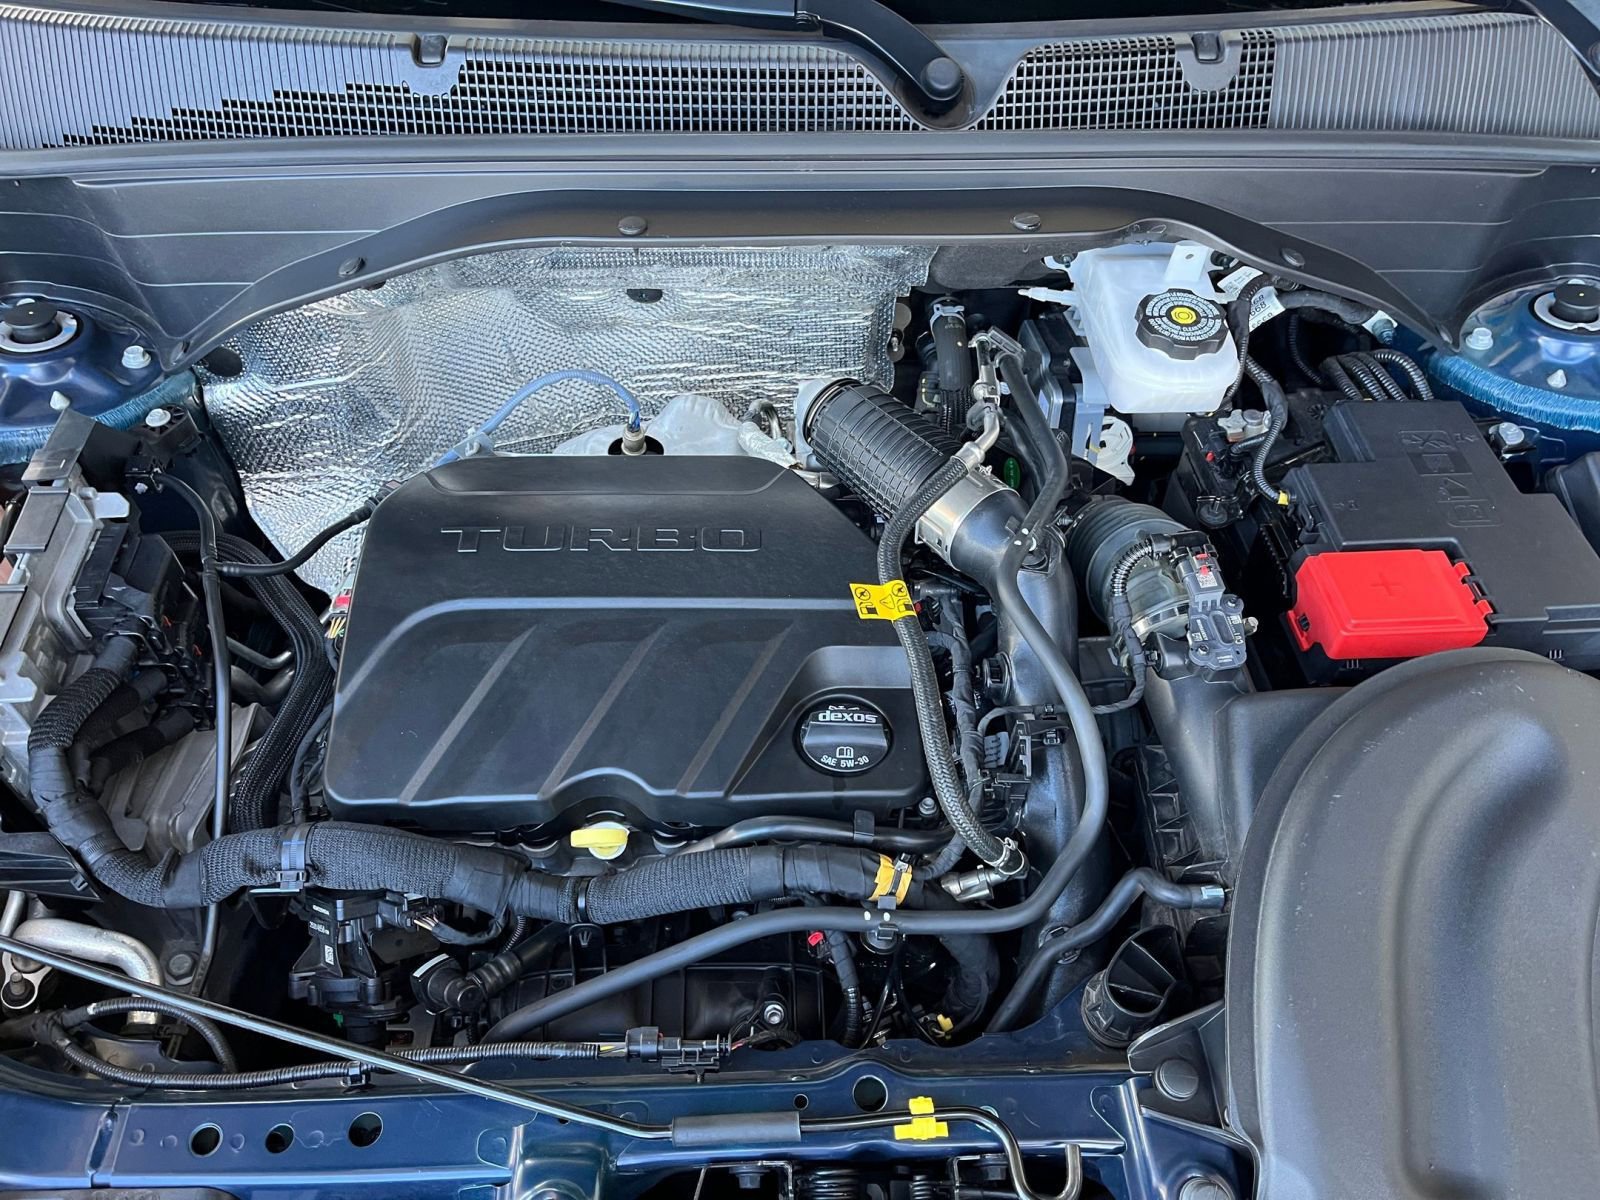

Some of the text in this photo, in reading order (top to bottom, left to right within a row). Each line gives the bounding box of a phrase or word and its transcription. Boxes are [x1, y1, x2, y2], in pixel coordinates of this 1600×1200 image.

[440, 526, 762, 553] TURBO
[818, 710, 878, 723] dexos
[821, 755, 869, 768] SAE 5W-30
